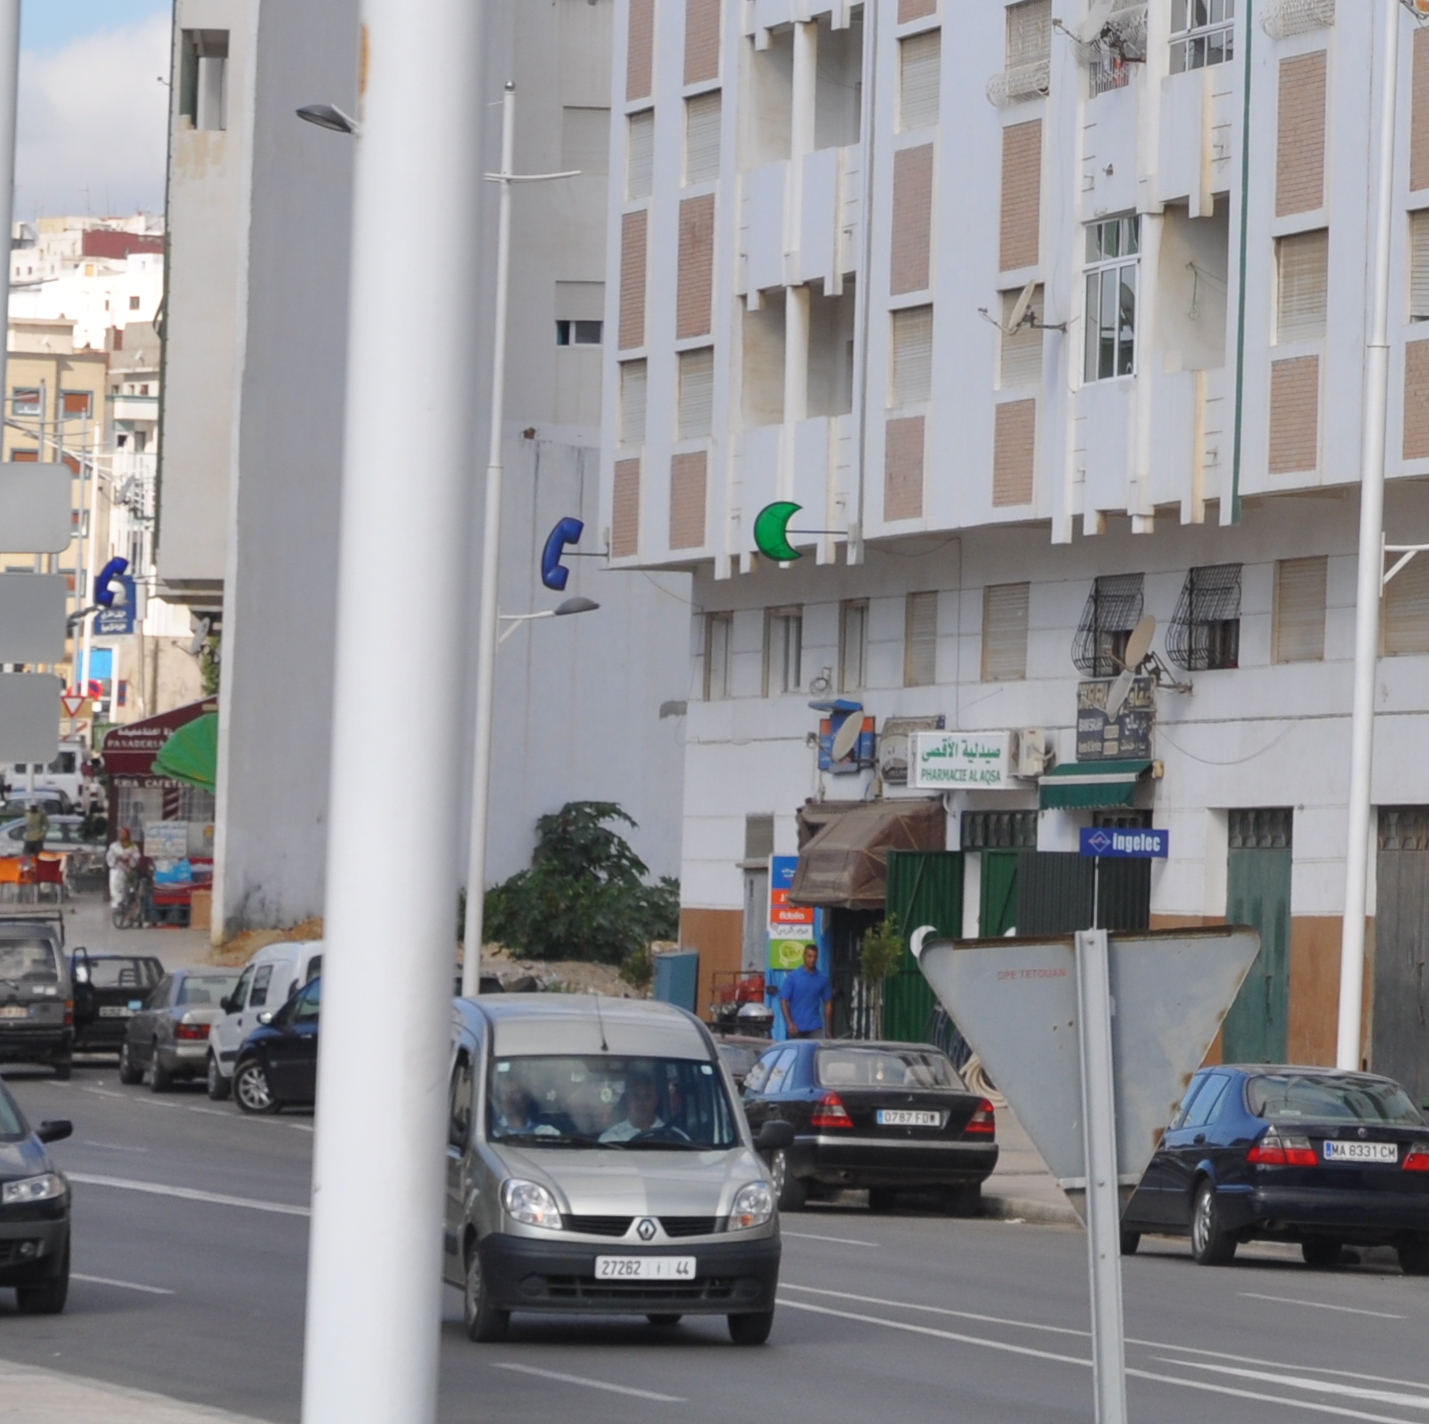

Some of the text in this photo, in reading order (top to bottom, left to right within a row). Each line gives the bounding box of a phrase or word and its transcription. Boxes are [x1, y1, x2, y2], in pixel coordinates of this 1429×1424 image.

[962, 738, 1001, 765] صيدلية
[920, 767, 967, 783] PHARMACIE
[967, 769, 979, 783] AL
[980, 769, 1002, 785] AQSA
[884, 1111, 913, 1123] 0787
[1331, 1143, 1396, 1159] MA 8331 CM
[601, 1260, 642, 1276] 27262
[675, 1260, 690, 1276] 44
